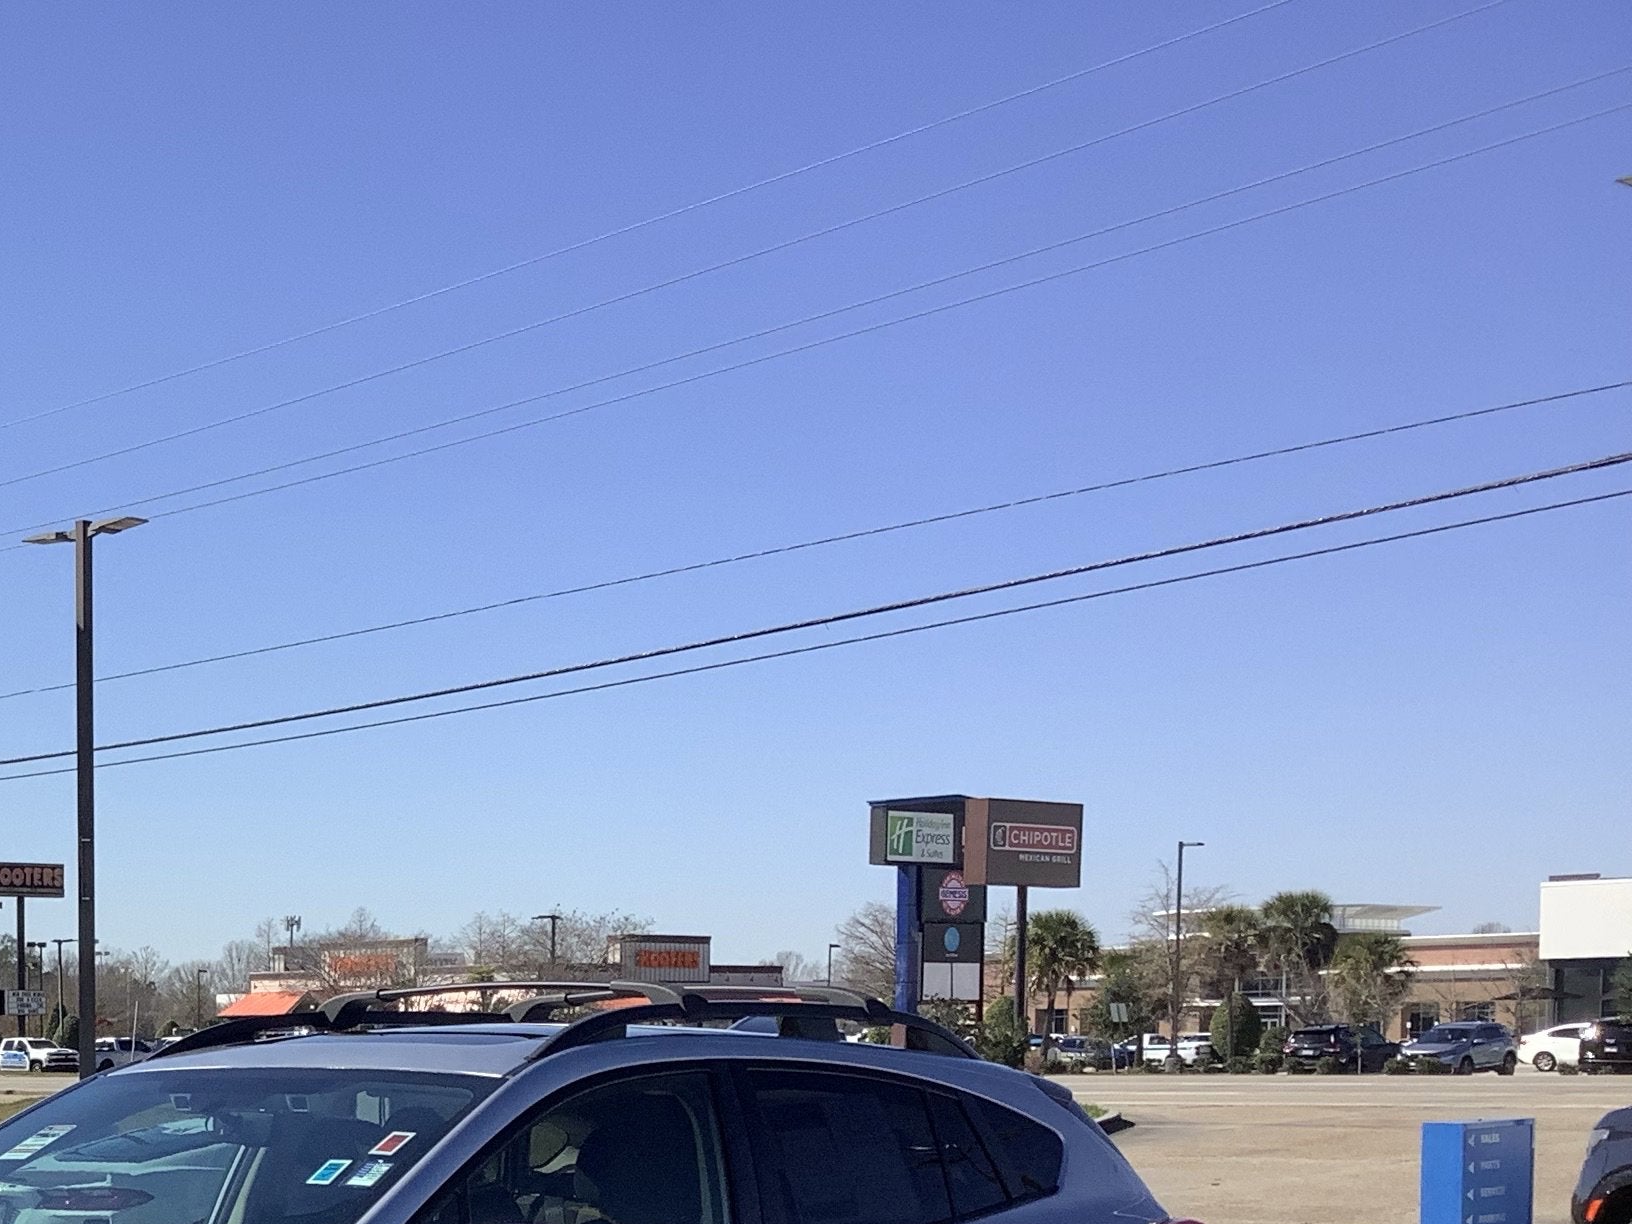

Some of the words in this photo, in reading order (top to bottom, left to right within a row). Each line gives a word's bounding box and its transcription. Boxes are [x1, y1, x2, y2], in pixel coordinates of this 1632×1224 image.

[915, 829, 950, 847] Express
[1010, 830, 1072, 847] CHIPOTLE
[1019, 854, 1050, 863] MEXICAN
[1052, 855, 1072, 864] GRILL
